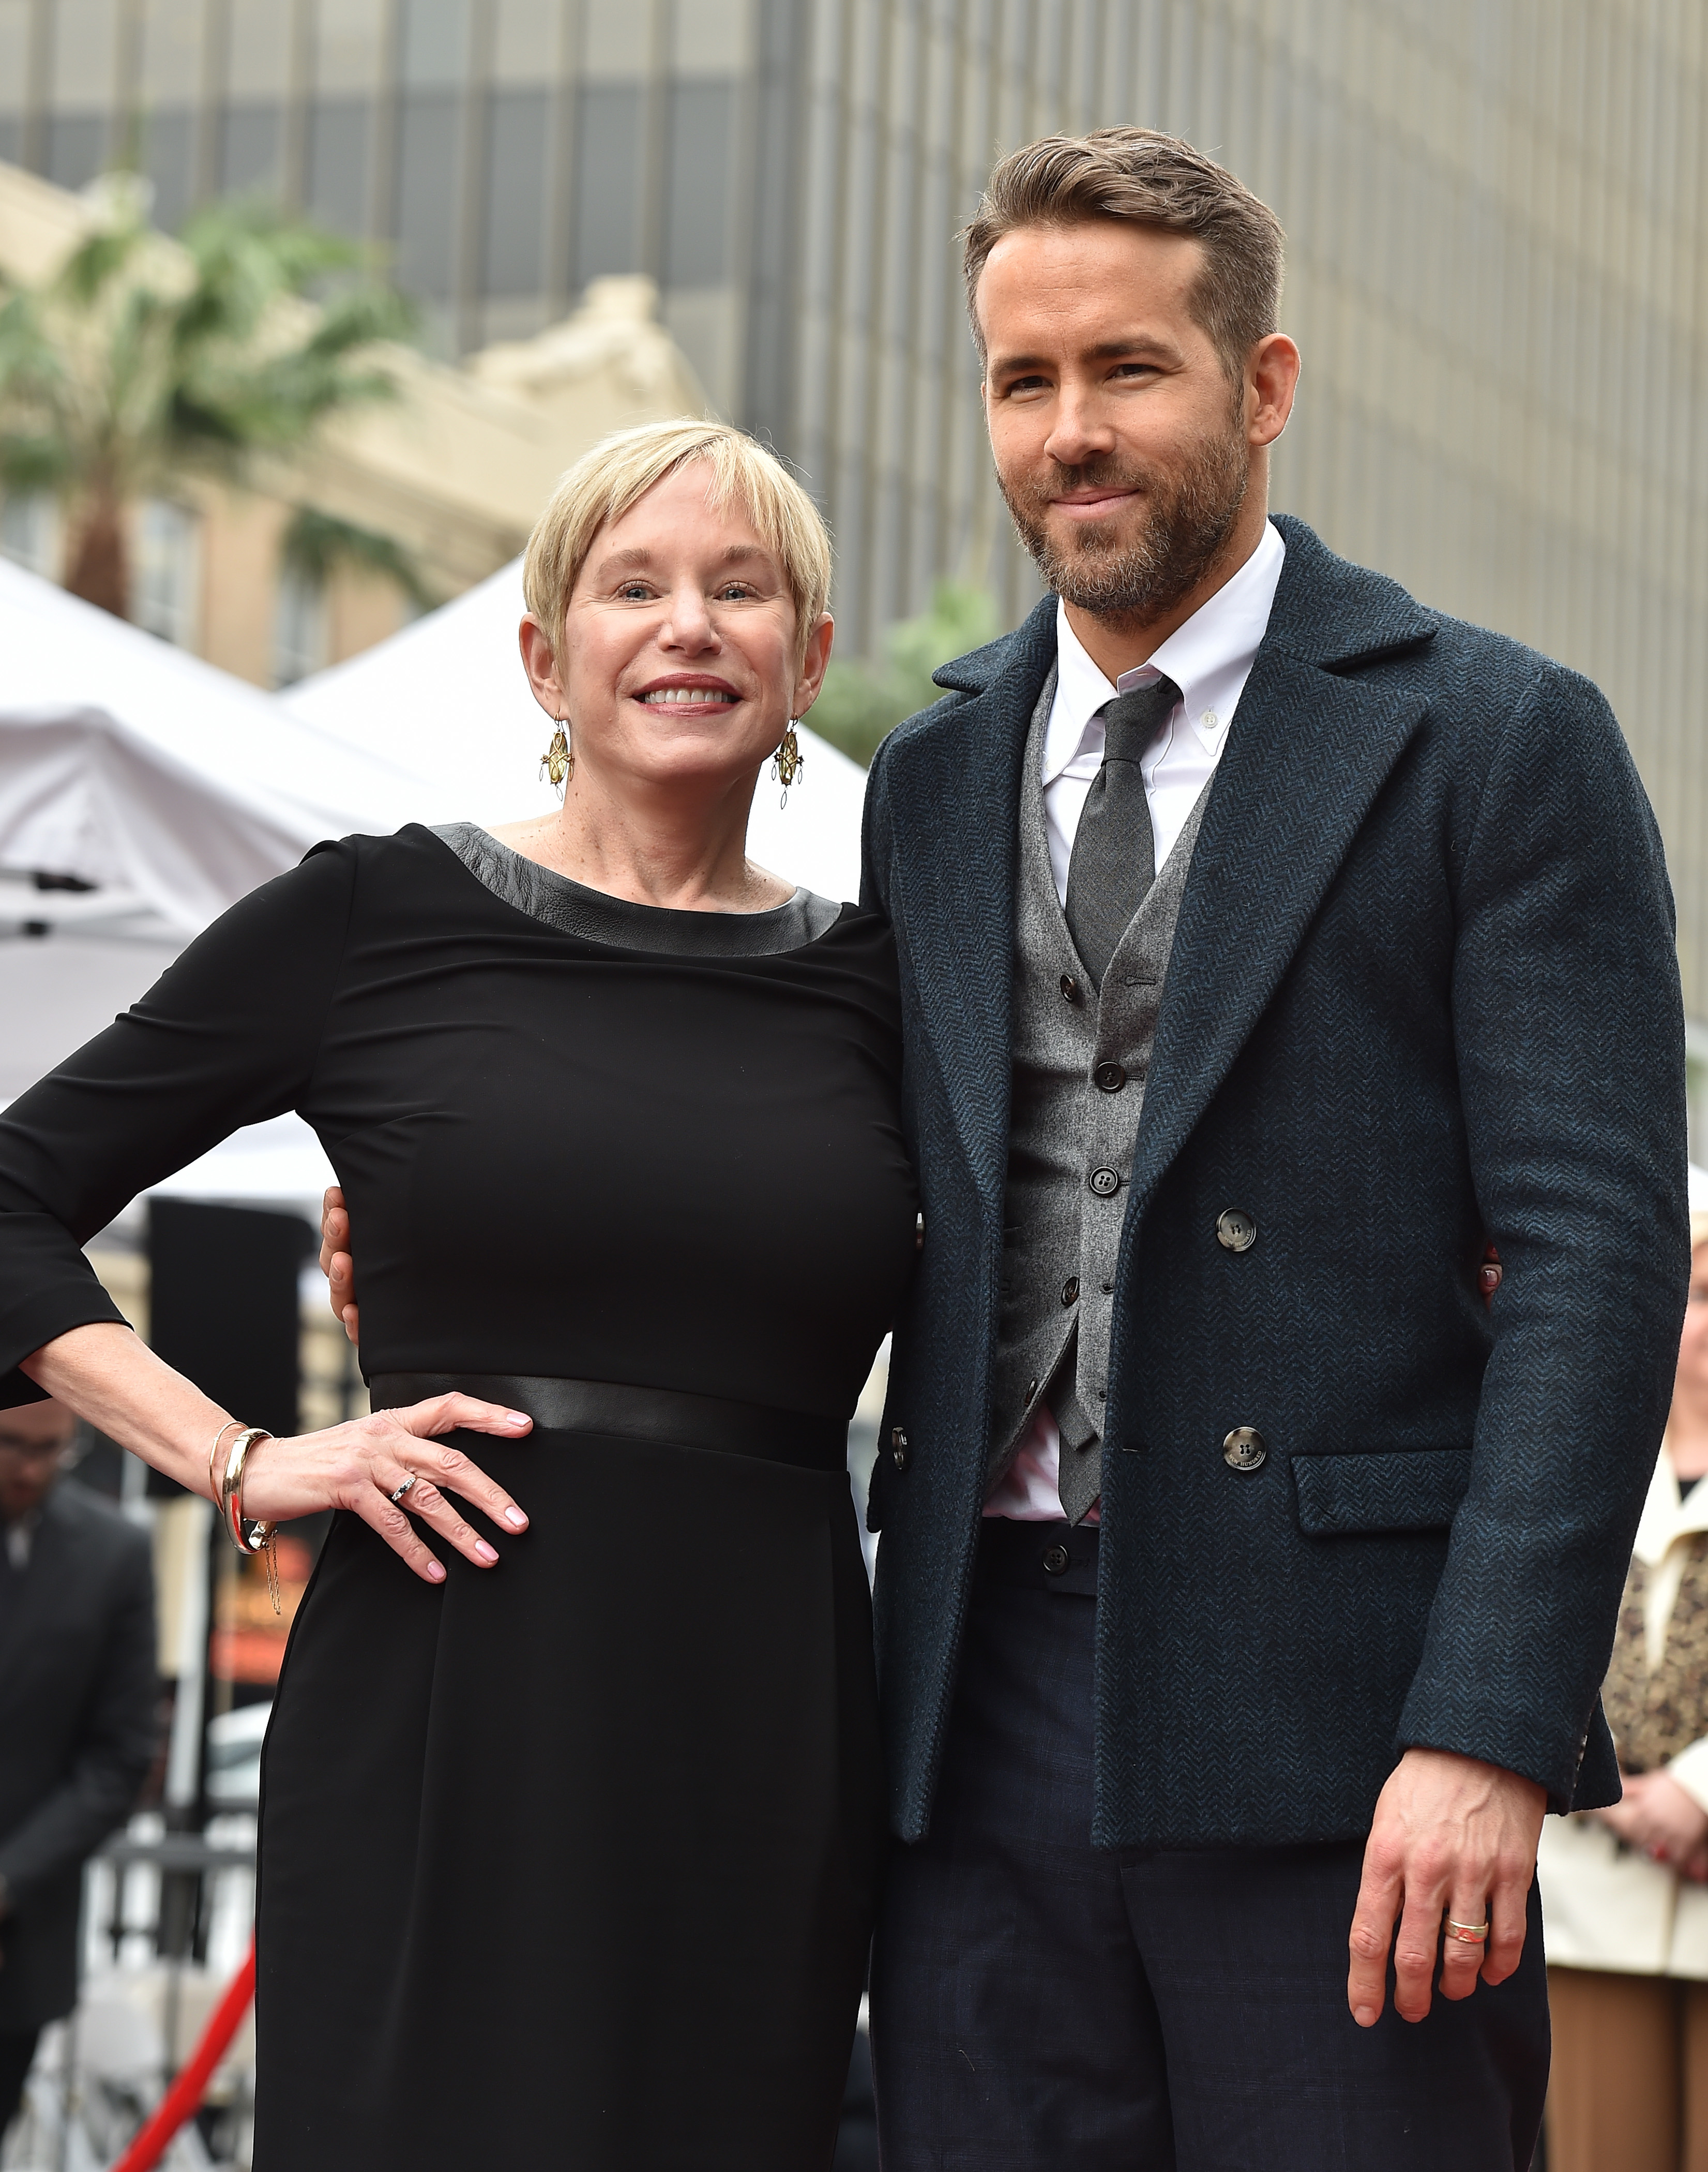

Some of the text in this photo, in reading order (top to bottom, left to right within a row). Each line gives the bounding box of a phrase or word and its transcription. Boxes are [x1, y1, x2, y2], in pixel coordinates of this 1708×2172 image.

[1235, 1229, 1251, 1246] HUNDRED
[1229, 1451, 1262, 1467] WON HUNDRED
